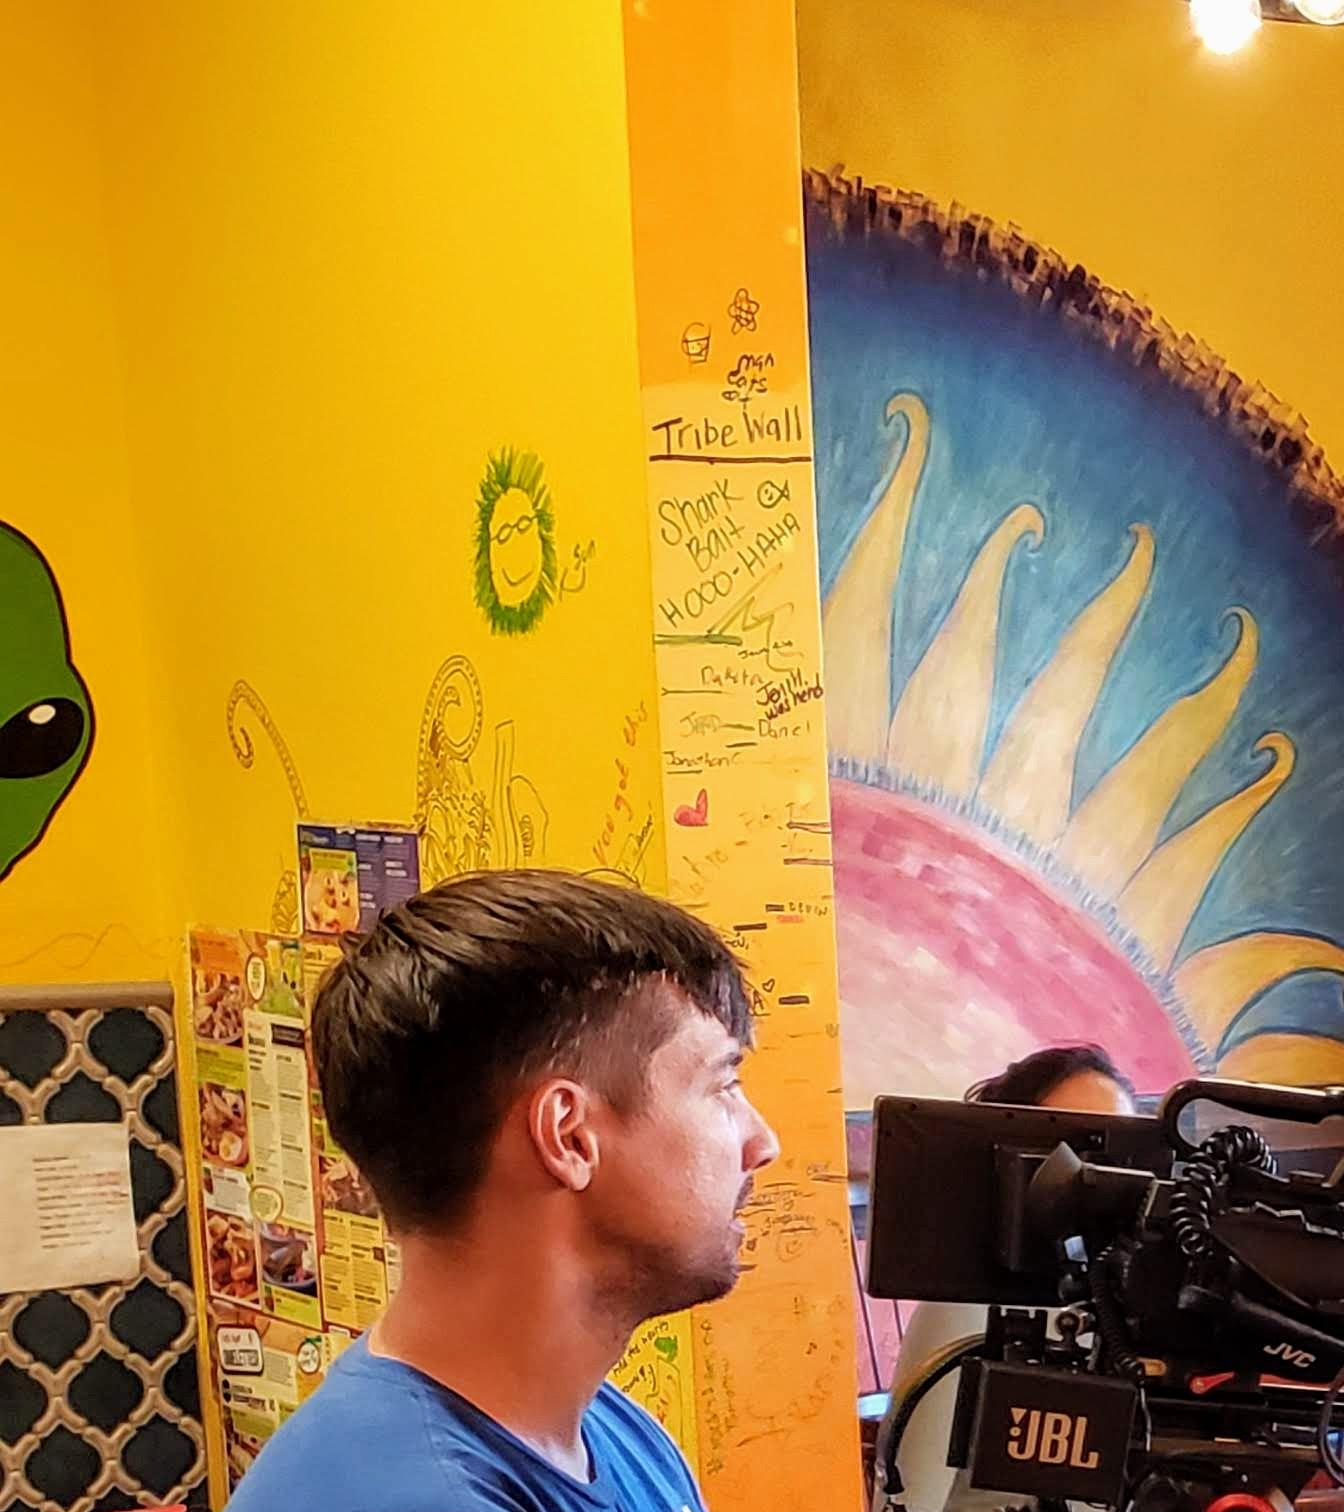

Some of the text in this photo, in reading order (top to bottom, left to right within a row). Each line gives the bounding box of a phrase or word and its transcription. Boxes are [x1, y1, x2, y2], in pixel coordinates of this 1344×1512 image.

[651, 404, 803, 457] Tribe Wall
[658, 478, 745, 547] Shark
[685, 515, 745, 573] Bait
[1262, 1342, 1317, 1369] JVC
[1007, 1408, 1099, 1469] JBL
